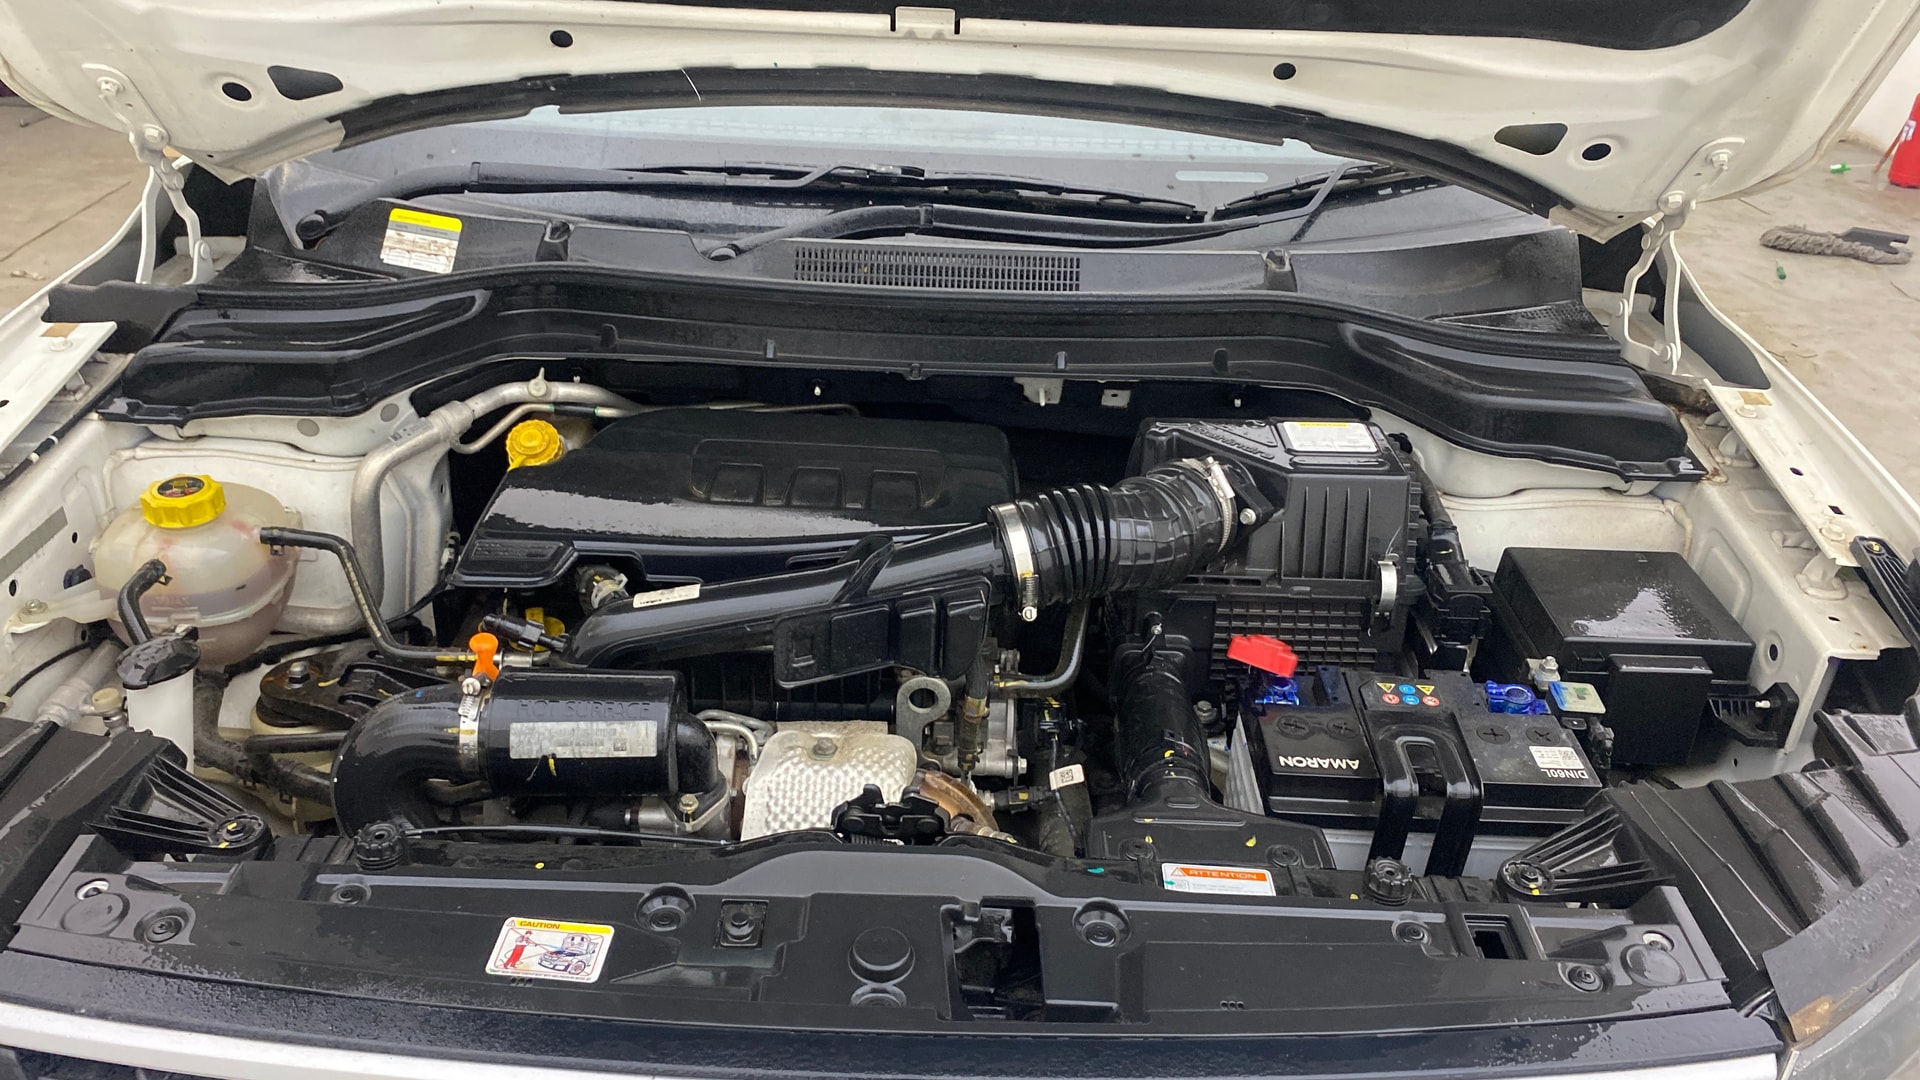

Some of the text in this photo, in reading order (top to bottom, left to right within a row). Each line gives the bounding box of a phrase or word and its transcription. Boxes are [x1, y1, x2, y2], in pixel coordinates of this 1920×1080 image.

[516, 699, 651, 720] HOT SURFACE
[1278, 755, 1360, 770] AMARON
[1540, 768, 1589, 779] DIN60L
[1189, 869, 1257, 880] ATTENTION
[519, 920, 561, 930] CAUTION
